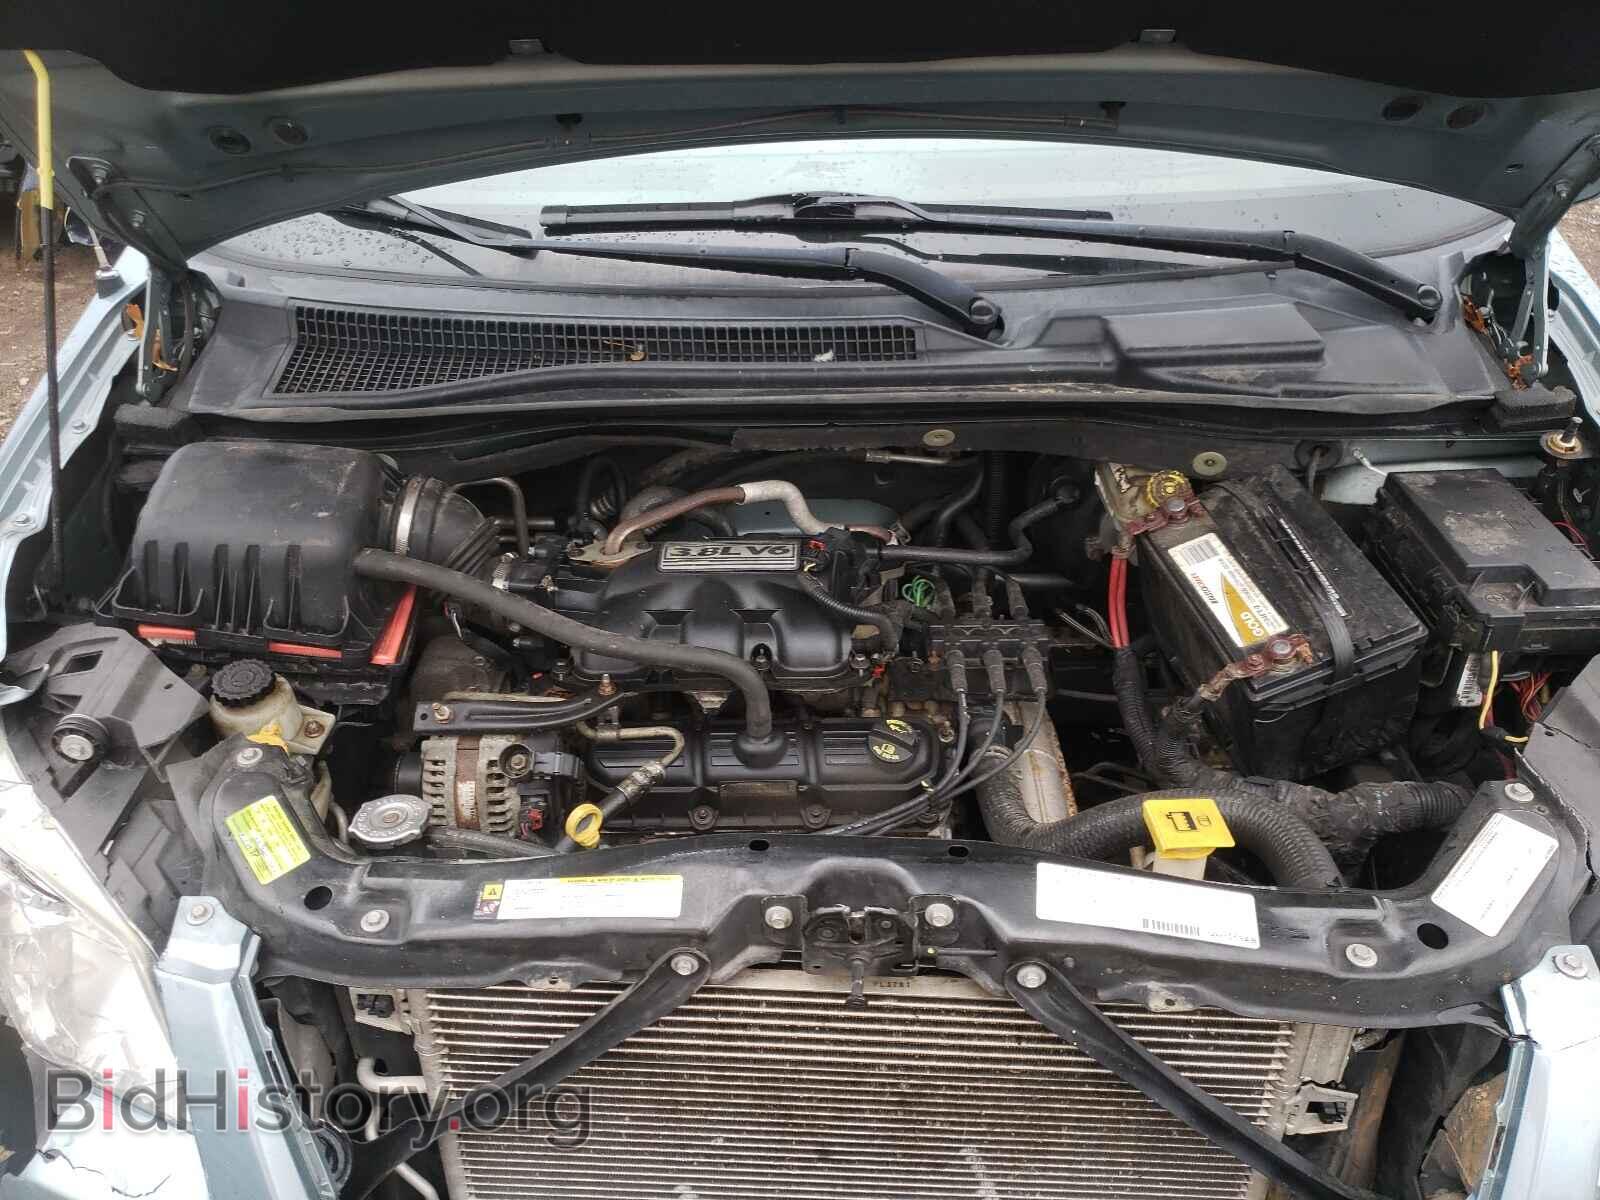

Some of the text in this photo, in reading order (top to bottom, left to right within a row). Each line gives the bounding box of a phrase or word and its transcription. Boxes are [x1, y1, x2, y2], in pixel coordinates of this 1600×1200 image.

[669, 545, 791, 557] 3.8L V6
[1240, 611, 1265, 637] GOLD
